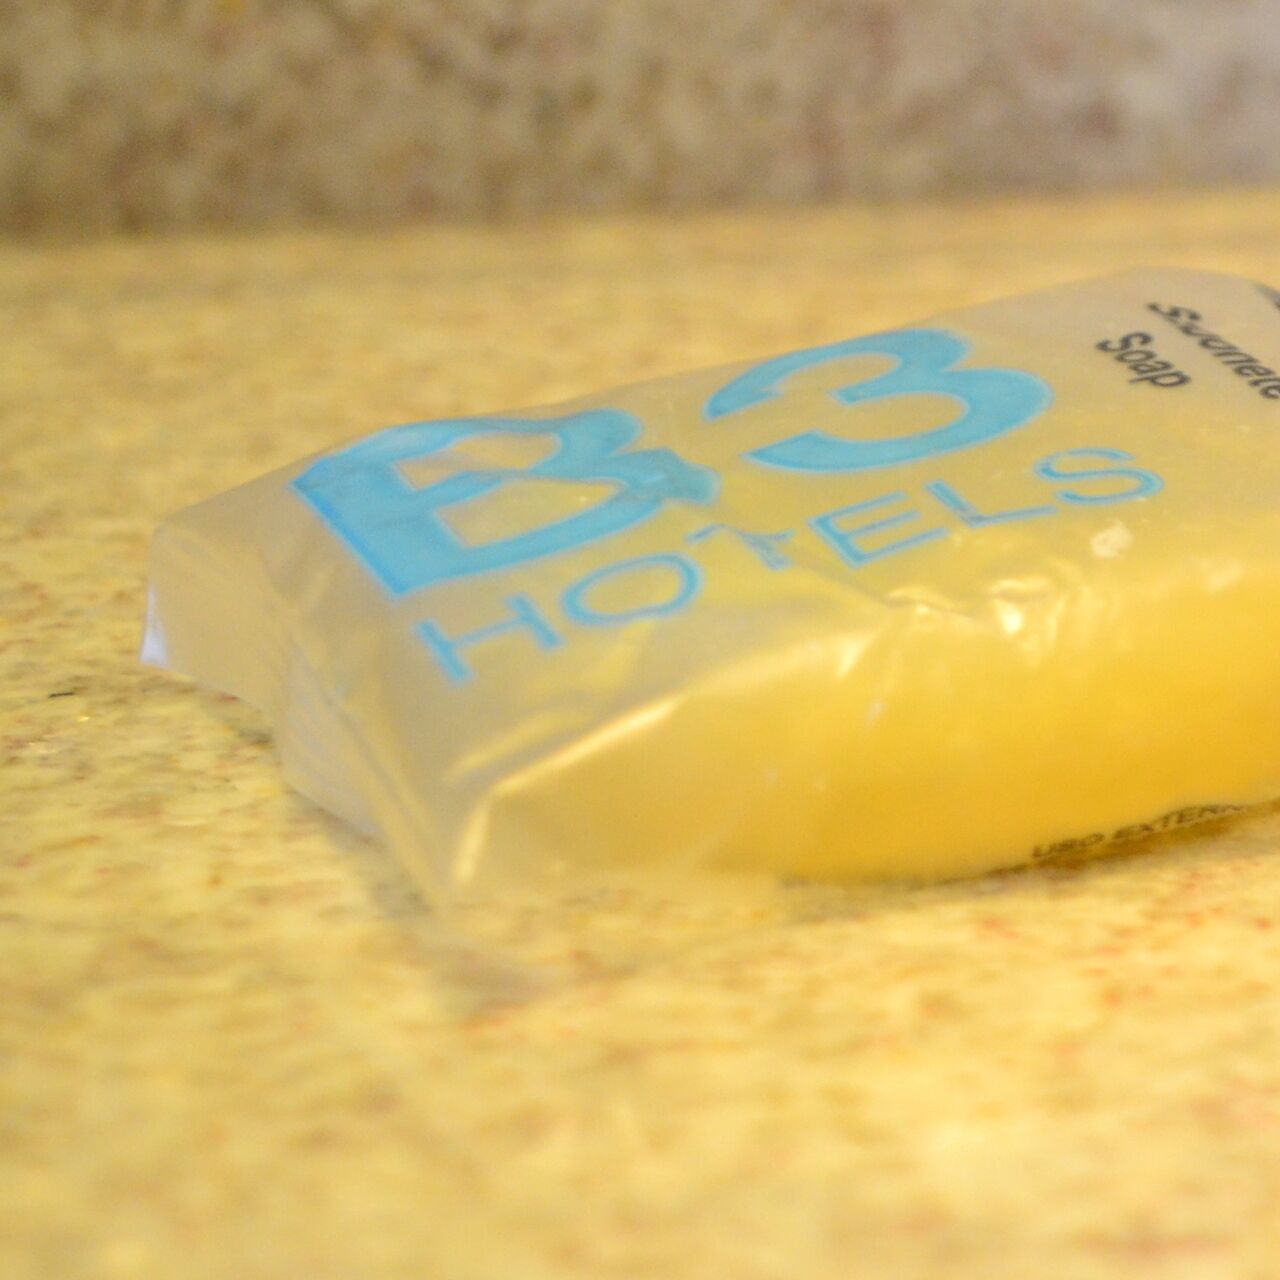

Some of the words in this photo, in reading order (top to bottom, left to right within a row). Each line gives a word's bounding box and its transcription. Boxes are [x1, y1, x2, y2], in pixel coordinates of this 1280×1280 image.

[290, 328, 1054, 599] B3
[1095, 330, 1192, 389] Soap
[412, 446, 1164, 685] HOTELS
